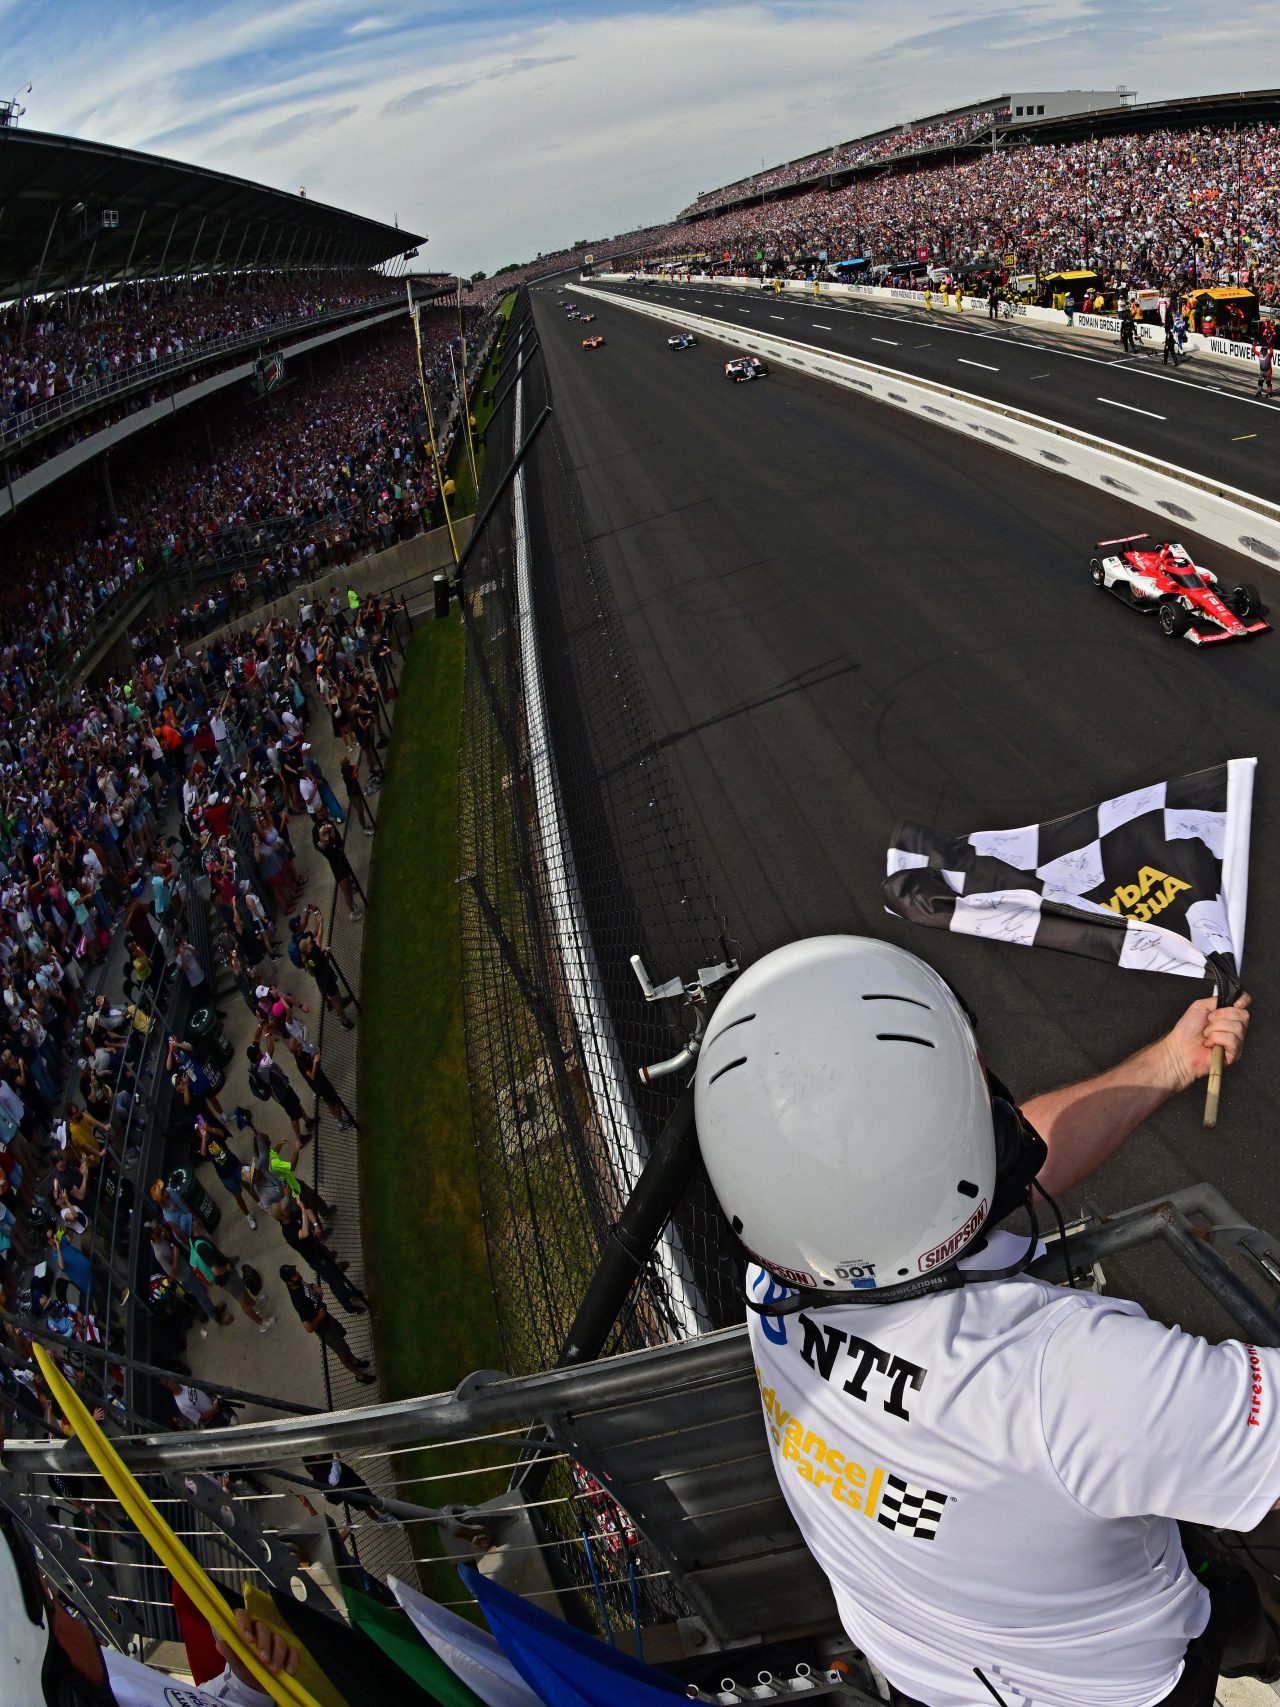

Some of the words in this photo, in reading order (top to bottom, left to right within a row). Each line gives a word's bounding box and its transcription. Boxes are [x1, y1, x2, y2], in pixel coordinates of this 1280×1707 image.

[1004, 254, 1014, 265] 26
[1078, 315, 1099, 328] ROMAIN
[1099, 319, 1124, 333] GROSJE
[1141, 326, 1152, 338] DHL
[1210, 339, 1226, 353] WILL
[1229, 343, 1256, 361] POWER
[924, 1203, 987, 1269] SIMPSON
[834, 1263, 876, 1279] DOT
[798, 1312, 928, 1422] NTT
[757, 1370, 867, 1489] dvance
[782, 1436, 862, 1510] Parts
